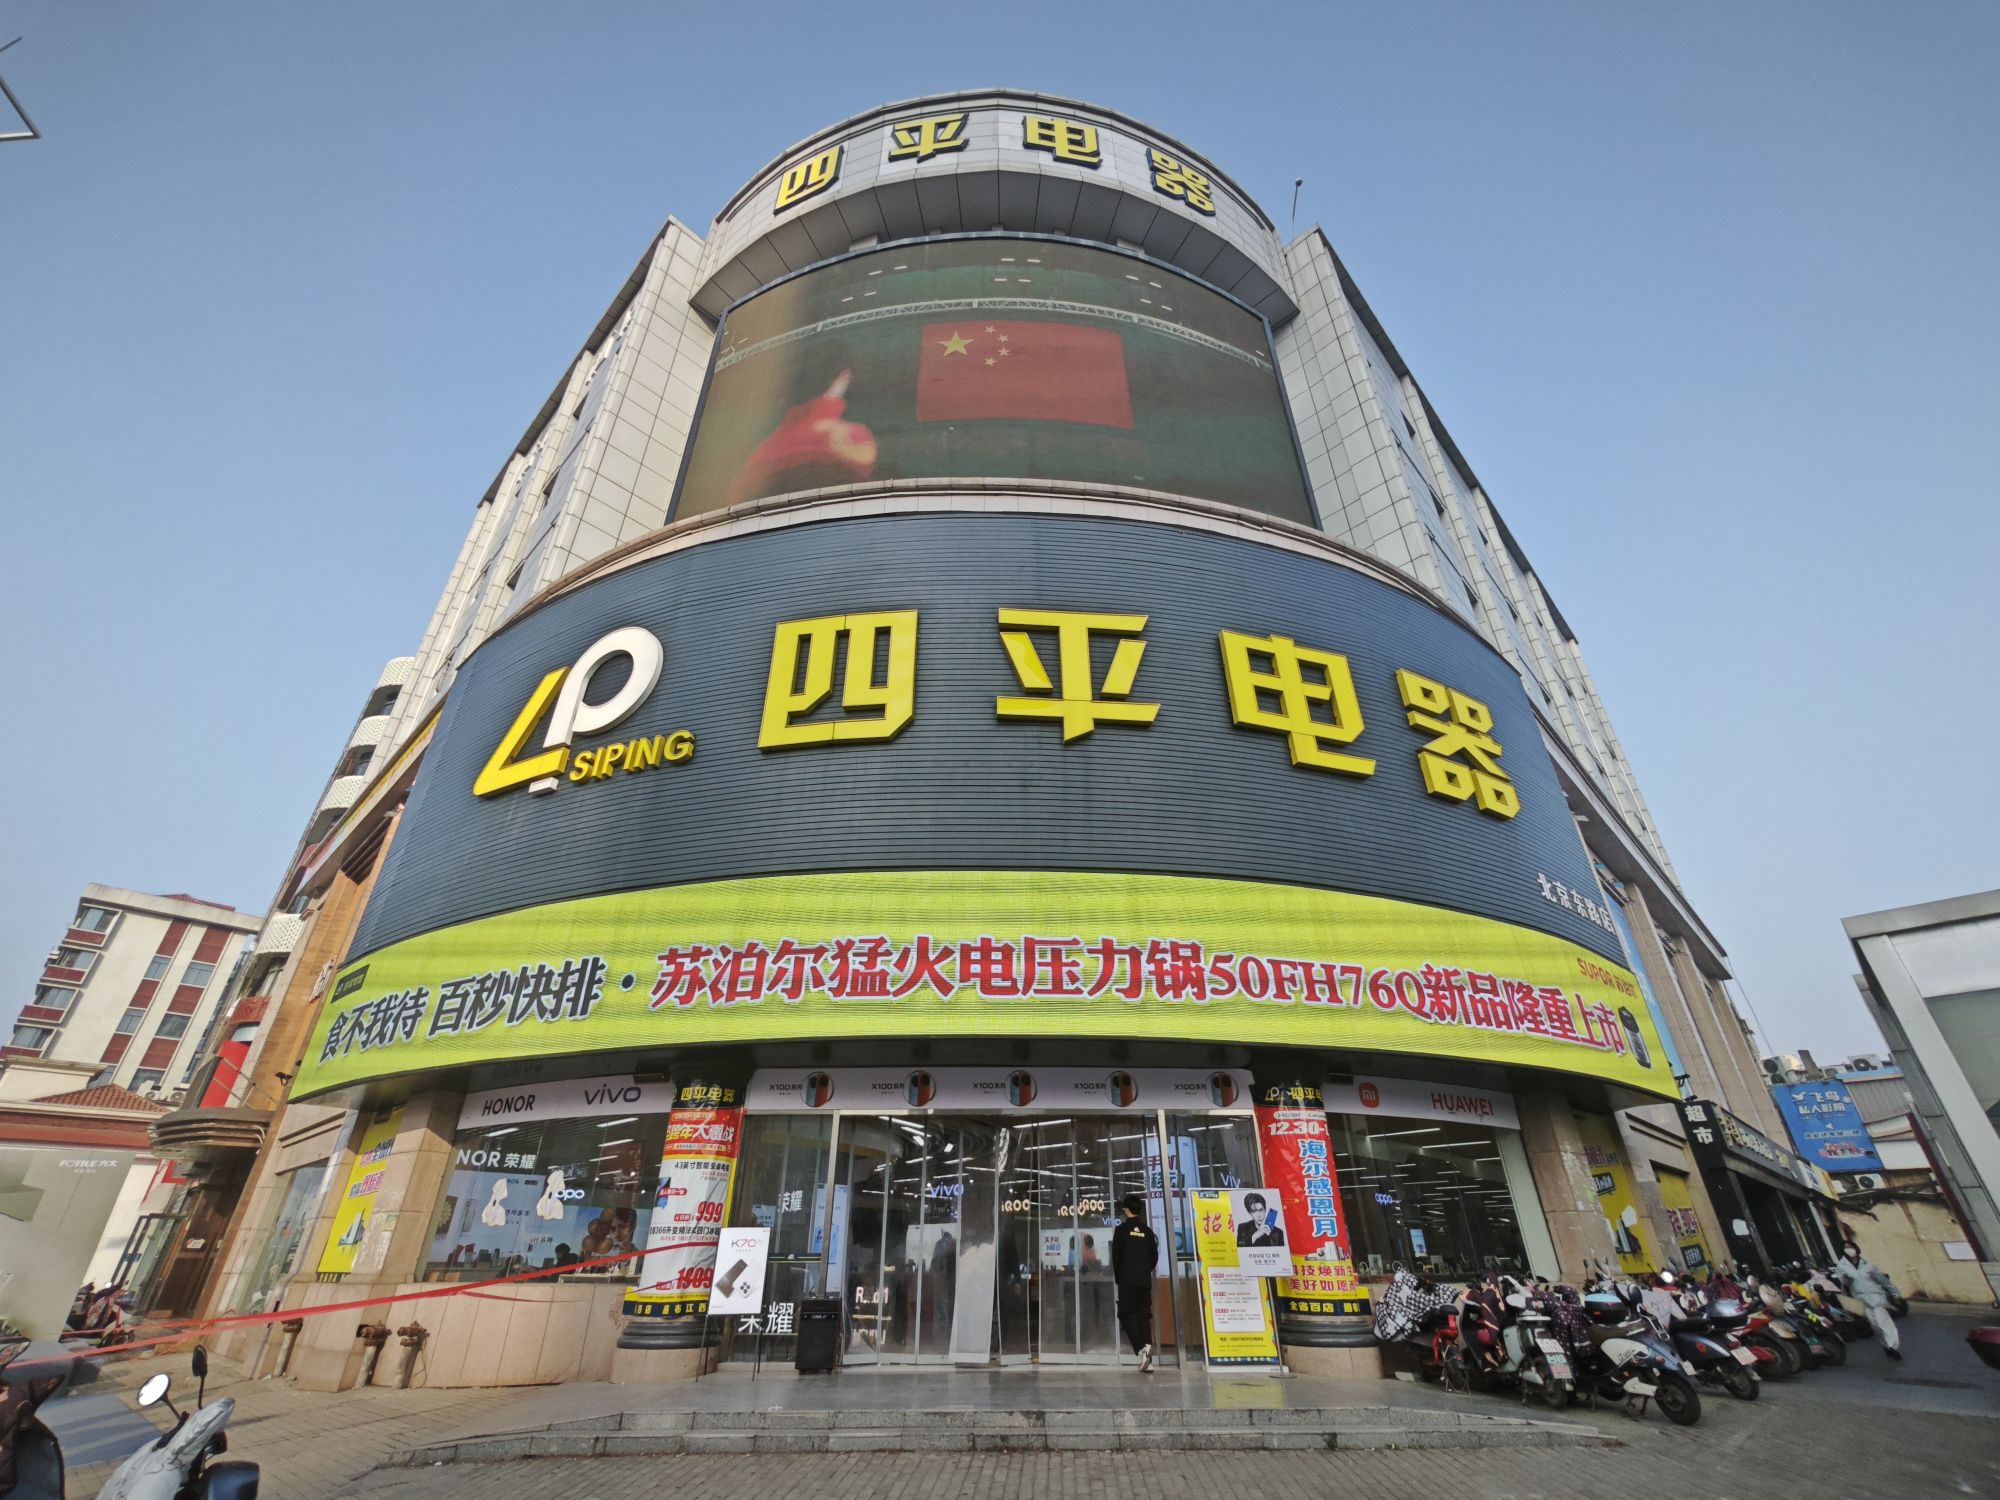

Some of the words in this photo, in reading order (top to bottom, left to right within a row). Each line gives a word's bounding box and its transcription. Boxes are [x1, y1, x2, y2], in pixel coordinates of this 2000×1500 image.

[773, 112, 1218, 217] 四平电器
[757, 607, 1522, 820] 四平电器
[568, 729, 696, 784] SIPING
[1536, 872, 1617, 936] 北京东路店
[482, 1094, 536, 1117] HONOR
[584, 1083, 642, 1105] vivo
[680, 1086, 736, 1102] 四平电器
[1431, 1091, 1494, 1117] HUAWEI
[1684, 1104, 1713, 1146] 超市
[503, 1152, 536, 1170] 荣耀
[930, 1181, 965, 1199] vivo
[1298, 1138, 1339, 1238] 海尔感恩月
[696, 1201, 724, 1223] 999
[731, 1239, 757, 1249] K70
[1289, 1301, 1335, 1314] 全省百店
